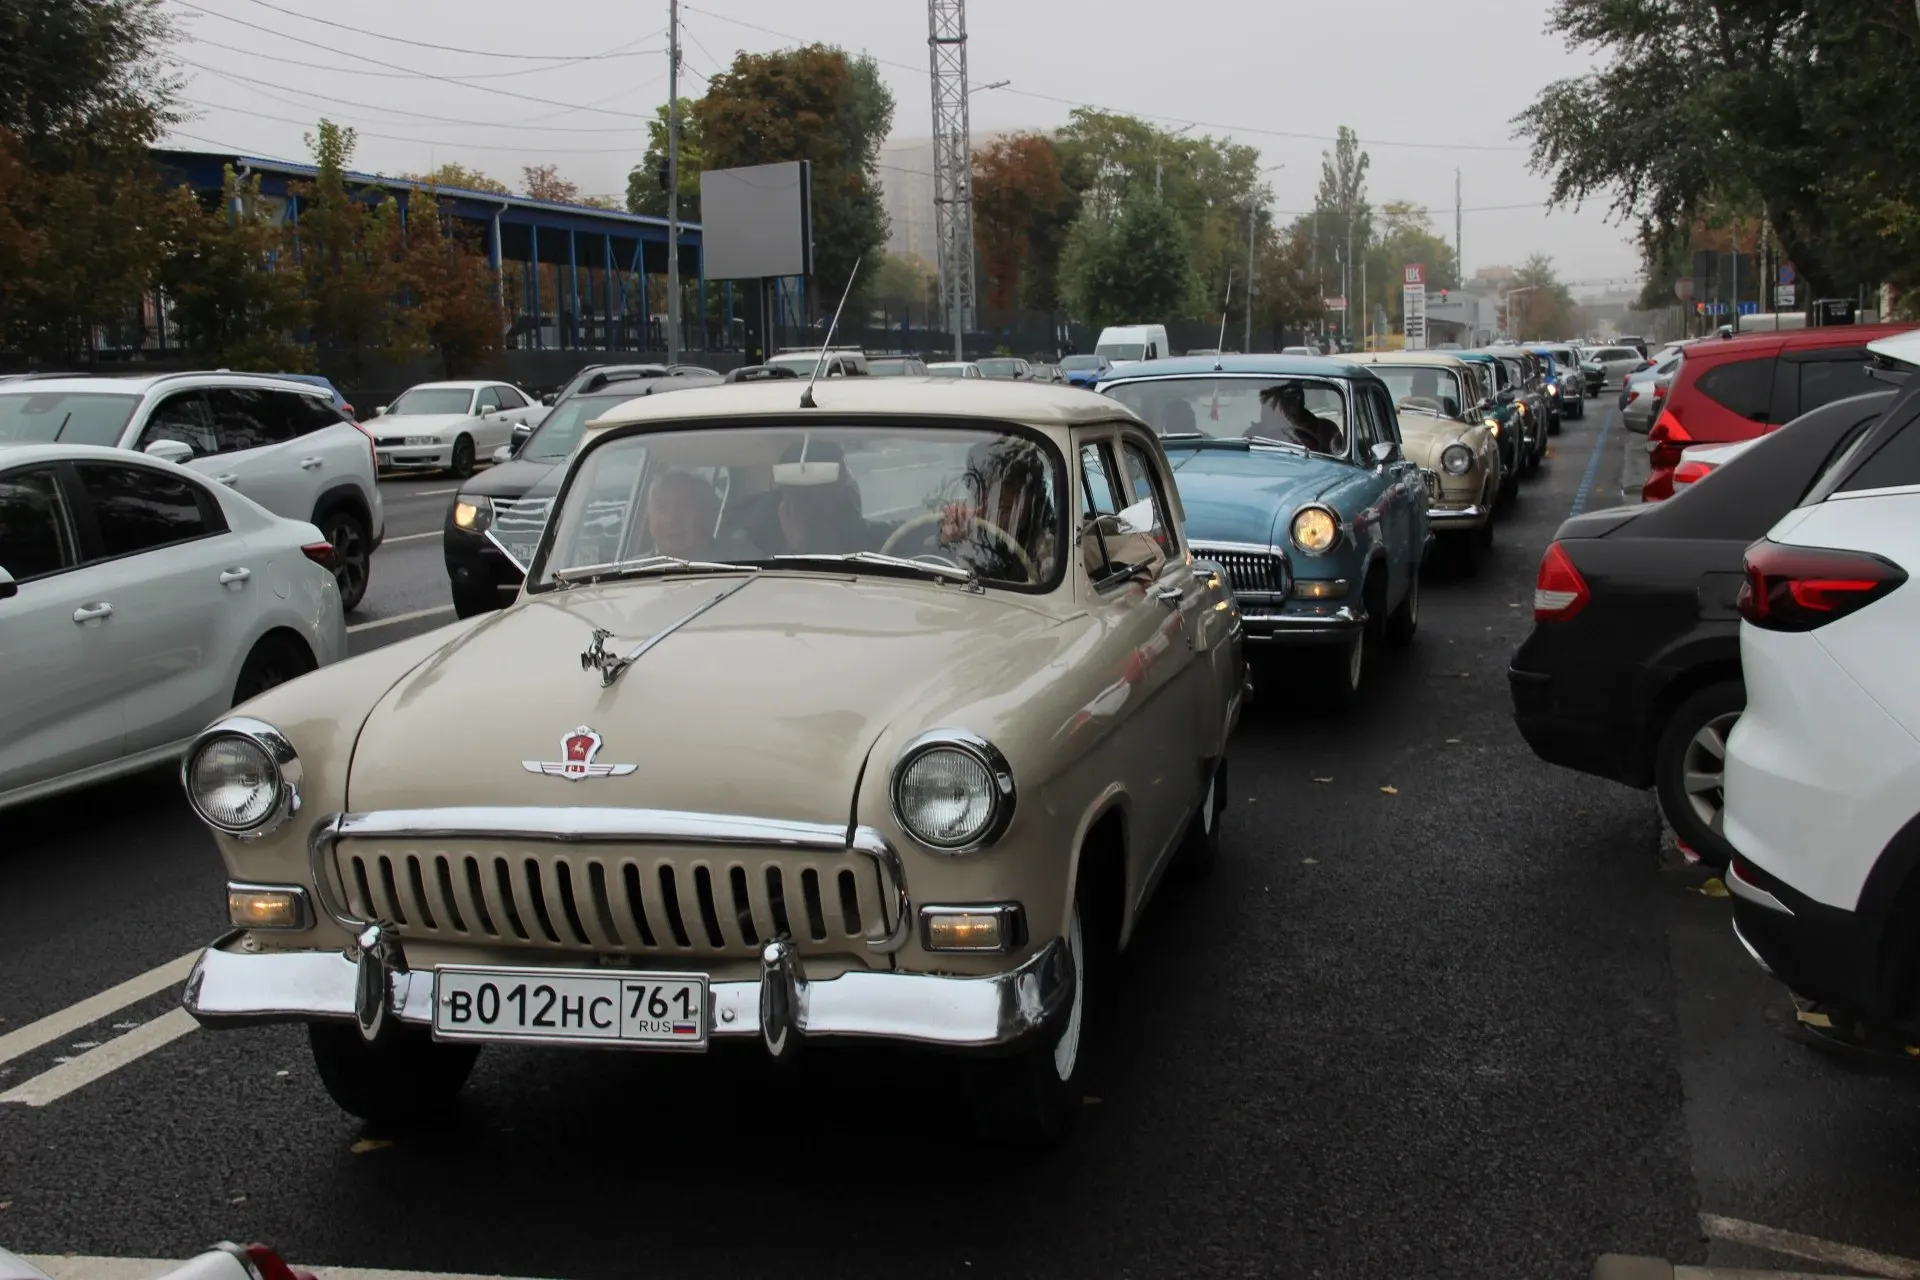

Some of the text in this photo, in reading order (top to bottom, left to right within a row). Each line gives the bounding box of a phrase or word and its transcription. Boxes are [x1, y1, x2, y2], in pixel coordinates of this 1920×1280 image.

[451, 982, 690, 1028] В012НС 761
[639, 1020, 671, 1032] RUS
